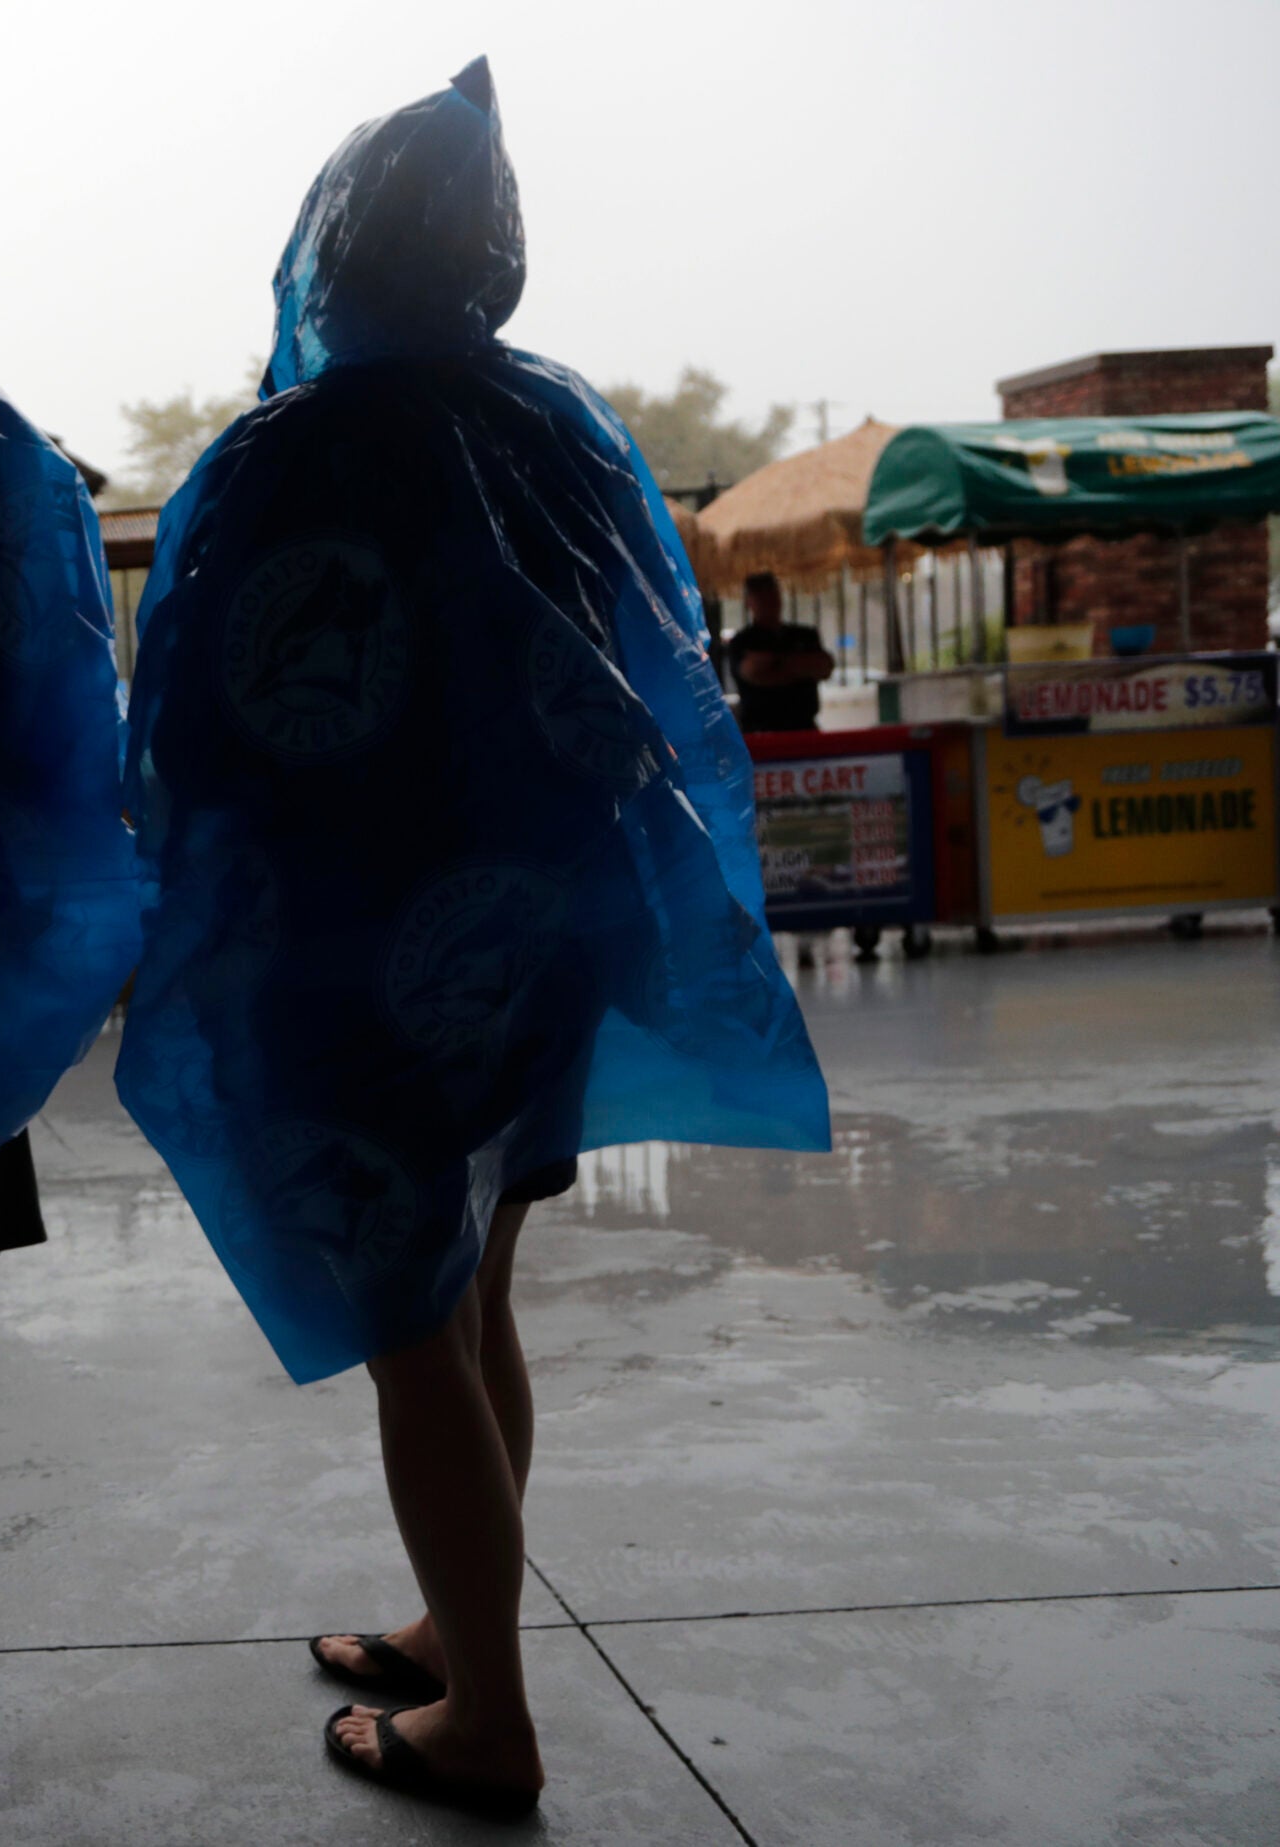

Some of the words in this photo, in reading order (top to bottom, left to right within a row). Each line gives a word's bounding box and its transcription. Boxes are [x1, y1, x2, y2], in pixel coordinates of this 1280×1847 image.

[227, 550, 318, 684] TORONTO
[1021, 679, 1168, 718] LEMONADE
[1186, 671, 1263, 708] $5.75
[265, 712, 356, 749] BLUE
[754, 769, 795, 799] EER
[803, 765, 867, 794] CART
[1090, 787, 1257, 840] LEMONADE
[393, 873, 497, 989] TORONTO
